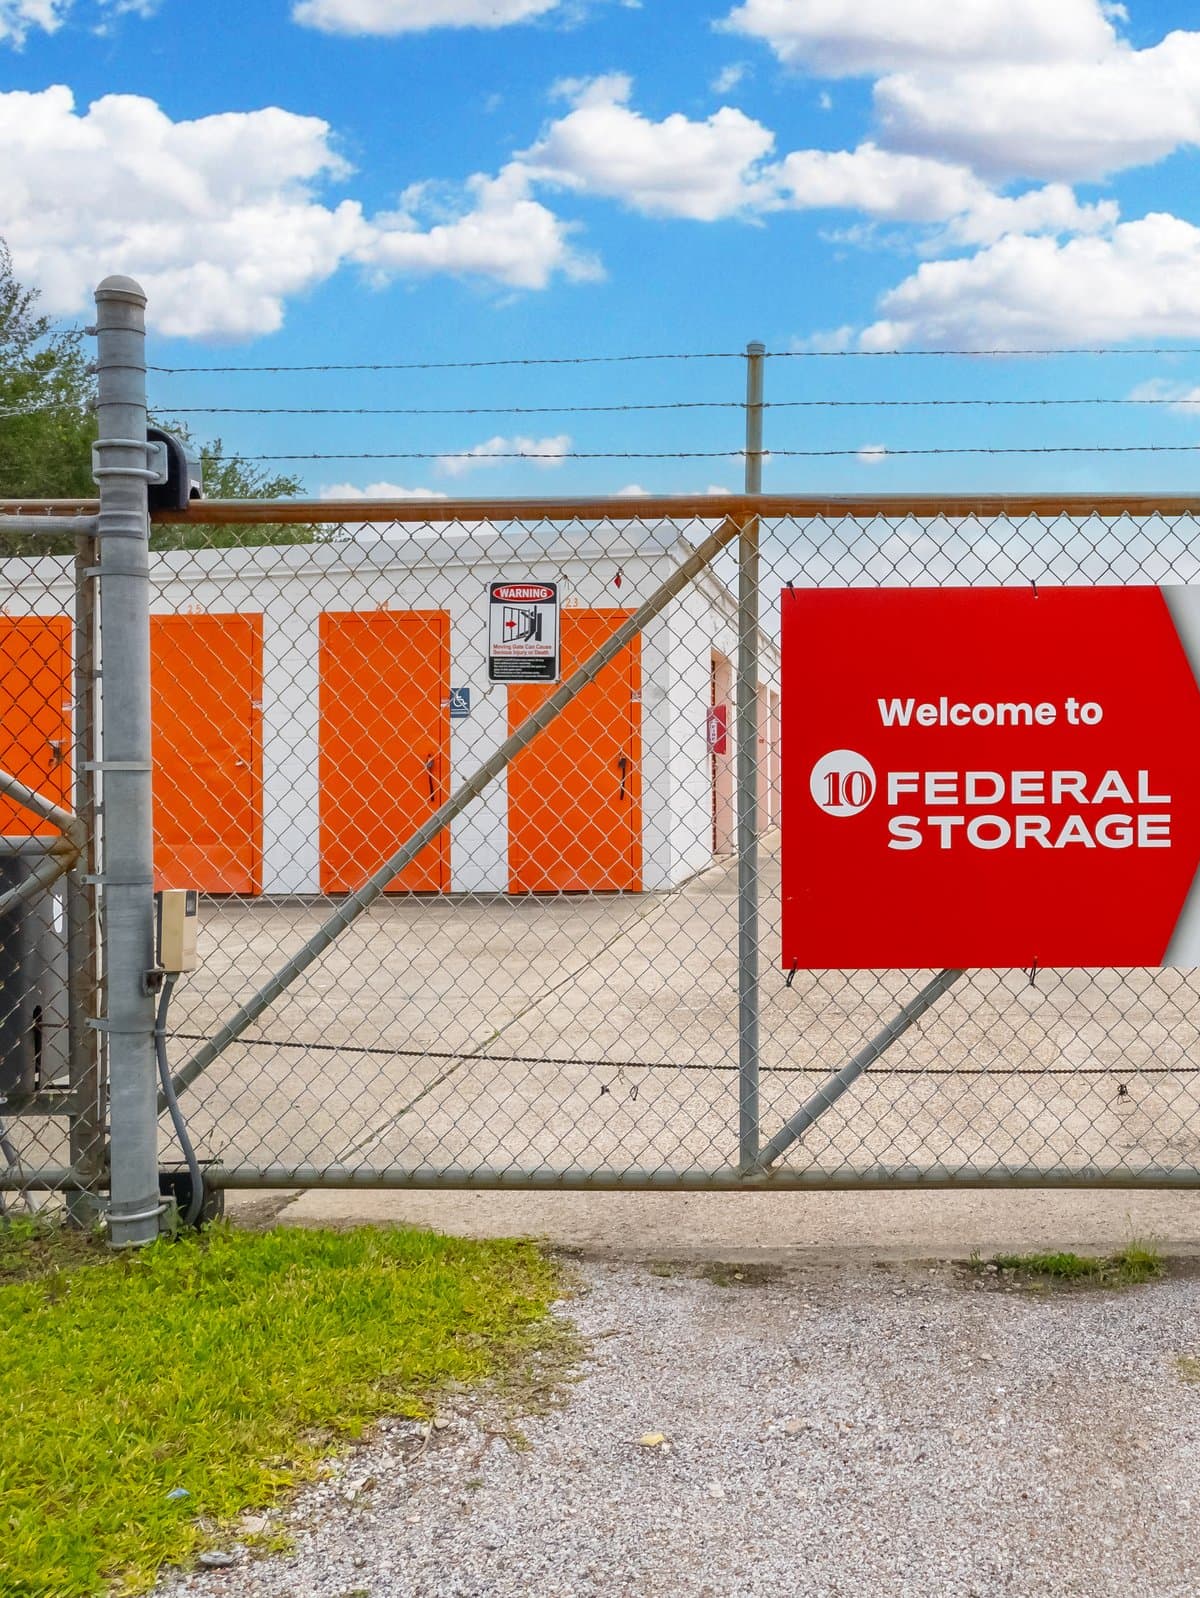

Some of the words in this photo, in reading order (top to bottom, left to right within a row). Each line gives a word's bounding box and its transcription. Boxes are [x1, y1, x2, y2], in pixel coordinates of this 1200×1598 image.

[499, 588, 548, 598] WARNING
[877, 696, 1057, 726] Welcome
[1065, 697, 1104, 726] to
[822, 770, 873, 808] 10
[887, 770, 1172, 806] FEDERAL
[887, 813, 1172, 850] STORAGE
